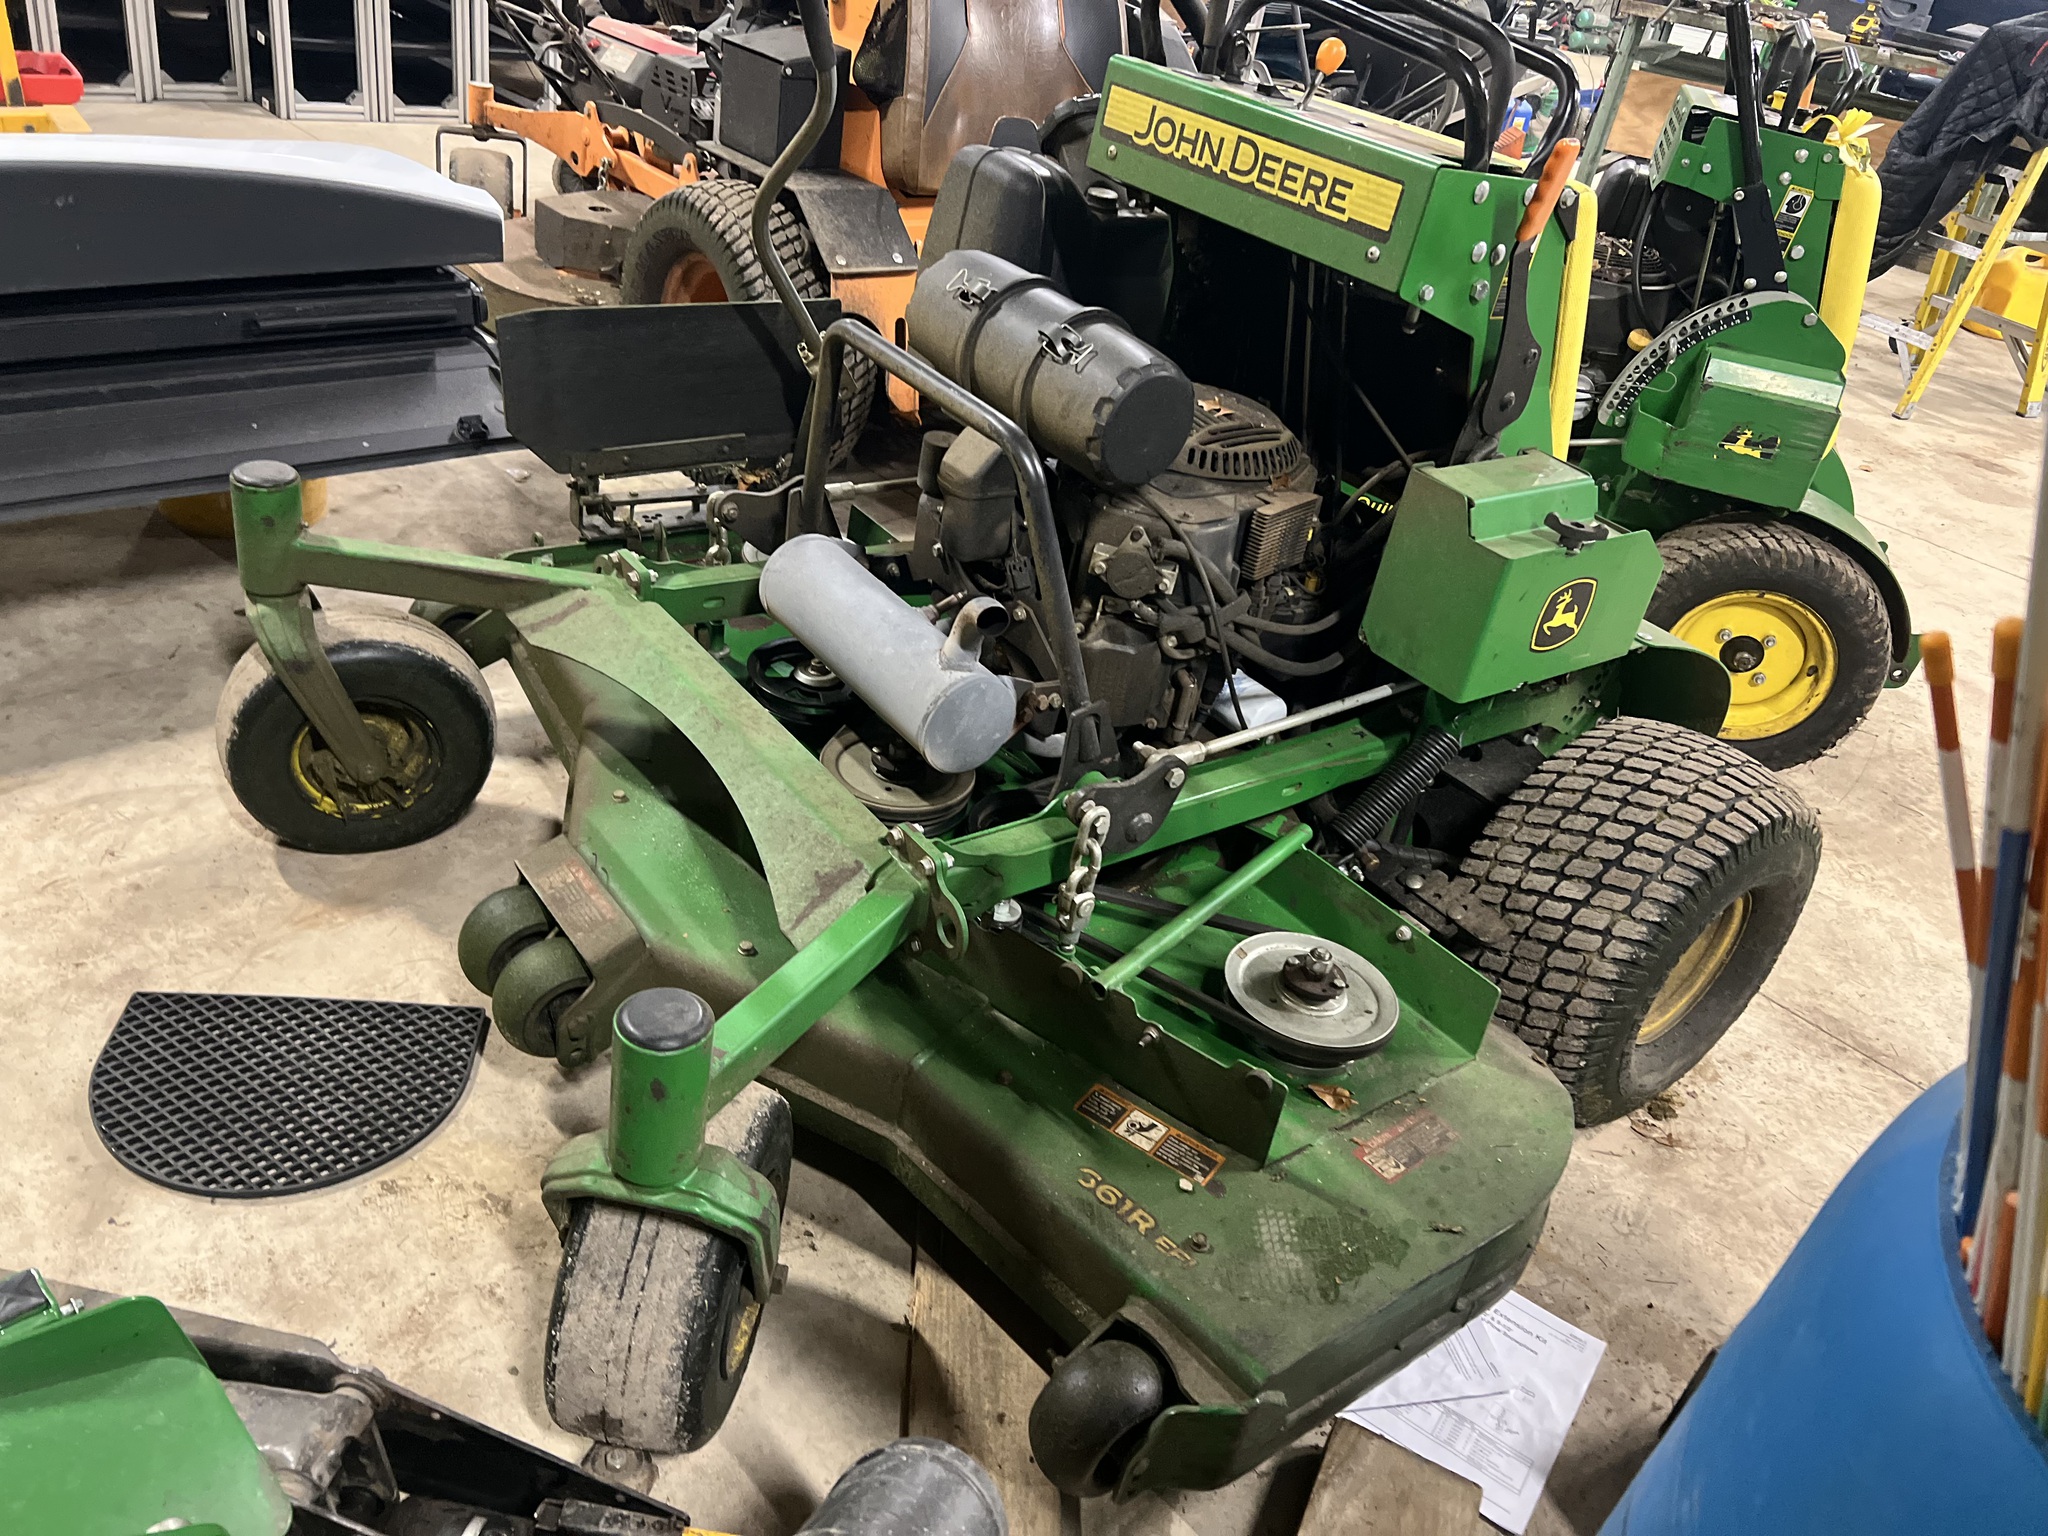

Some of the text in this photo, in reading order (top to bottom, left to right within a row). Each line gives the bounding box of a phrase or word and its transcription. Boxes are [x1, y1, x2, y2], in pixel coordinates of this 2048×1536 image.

[1134, 105, 1354, 215] JOHN DEERE
[1493, 1308, 1534, 1337] Extension
[1535, 1334, 1548, 1345] Kit
